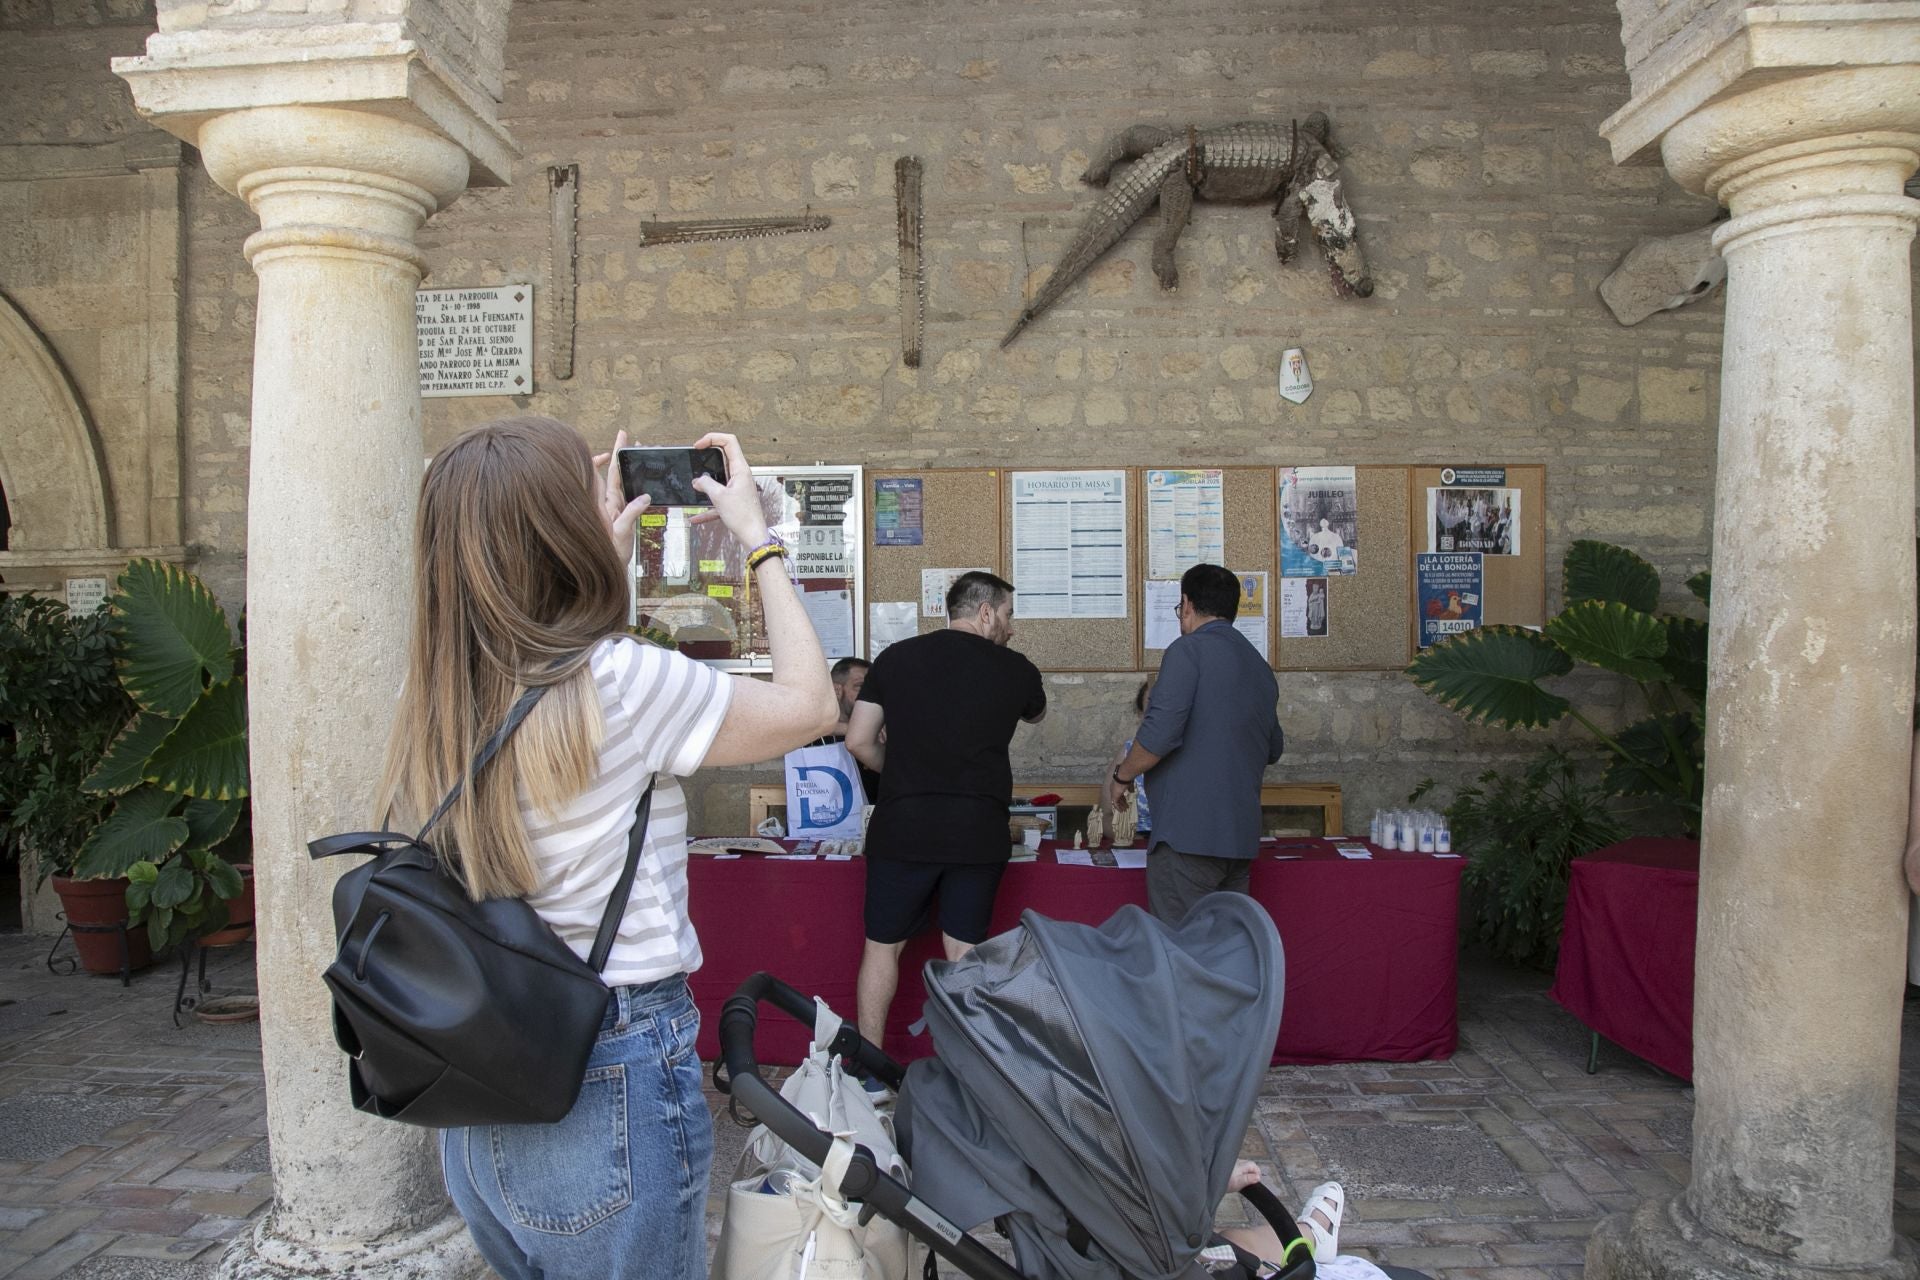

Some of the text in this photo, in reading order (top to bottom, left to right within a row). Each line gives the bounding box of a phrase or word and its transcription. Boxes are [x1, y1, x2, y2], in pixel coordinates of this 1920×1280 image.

[433, 294, 441, 302] DE
[445, 293, 454, 302] LA
[460, 291, 498, 301] PARROQUIA
[459, 314, 466, 323] DE
[470, 313, 479, 322] LA
[449, 326, 457, 335] EL
[461, 325, 469, 334] 24
[473, 325, 481, 333] DE
[485, 324, 516, 333] OCTUBRE
[427, 338, 435, 346] DE
[490, 335, 514, 344] SIENDO
[440, 359, 471, 369] PARROCO
[473, 359, 481, 368] DE
[484, 359, 493, 367] LA
[496, 358, 520, 367] MISMA
[475, 381, 486, 389] DEL
[1027, 480, 1111, 489] HORARIO DE MISAS
[1308, 490, 1344, 499] JUBILEO
[1459, 540, 1494, 548] BONDAD
[834, 552, 843, 561] LA
[1440, 554, 1473, 563] LOTERÍA
[816, 565, 824, 573] DE
[1444, 563, 1481, 571] BONDAD!
[1442, 622, 1471, 632] 14010
[936, 1222, 956, 1240] MUUM
